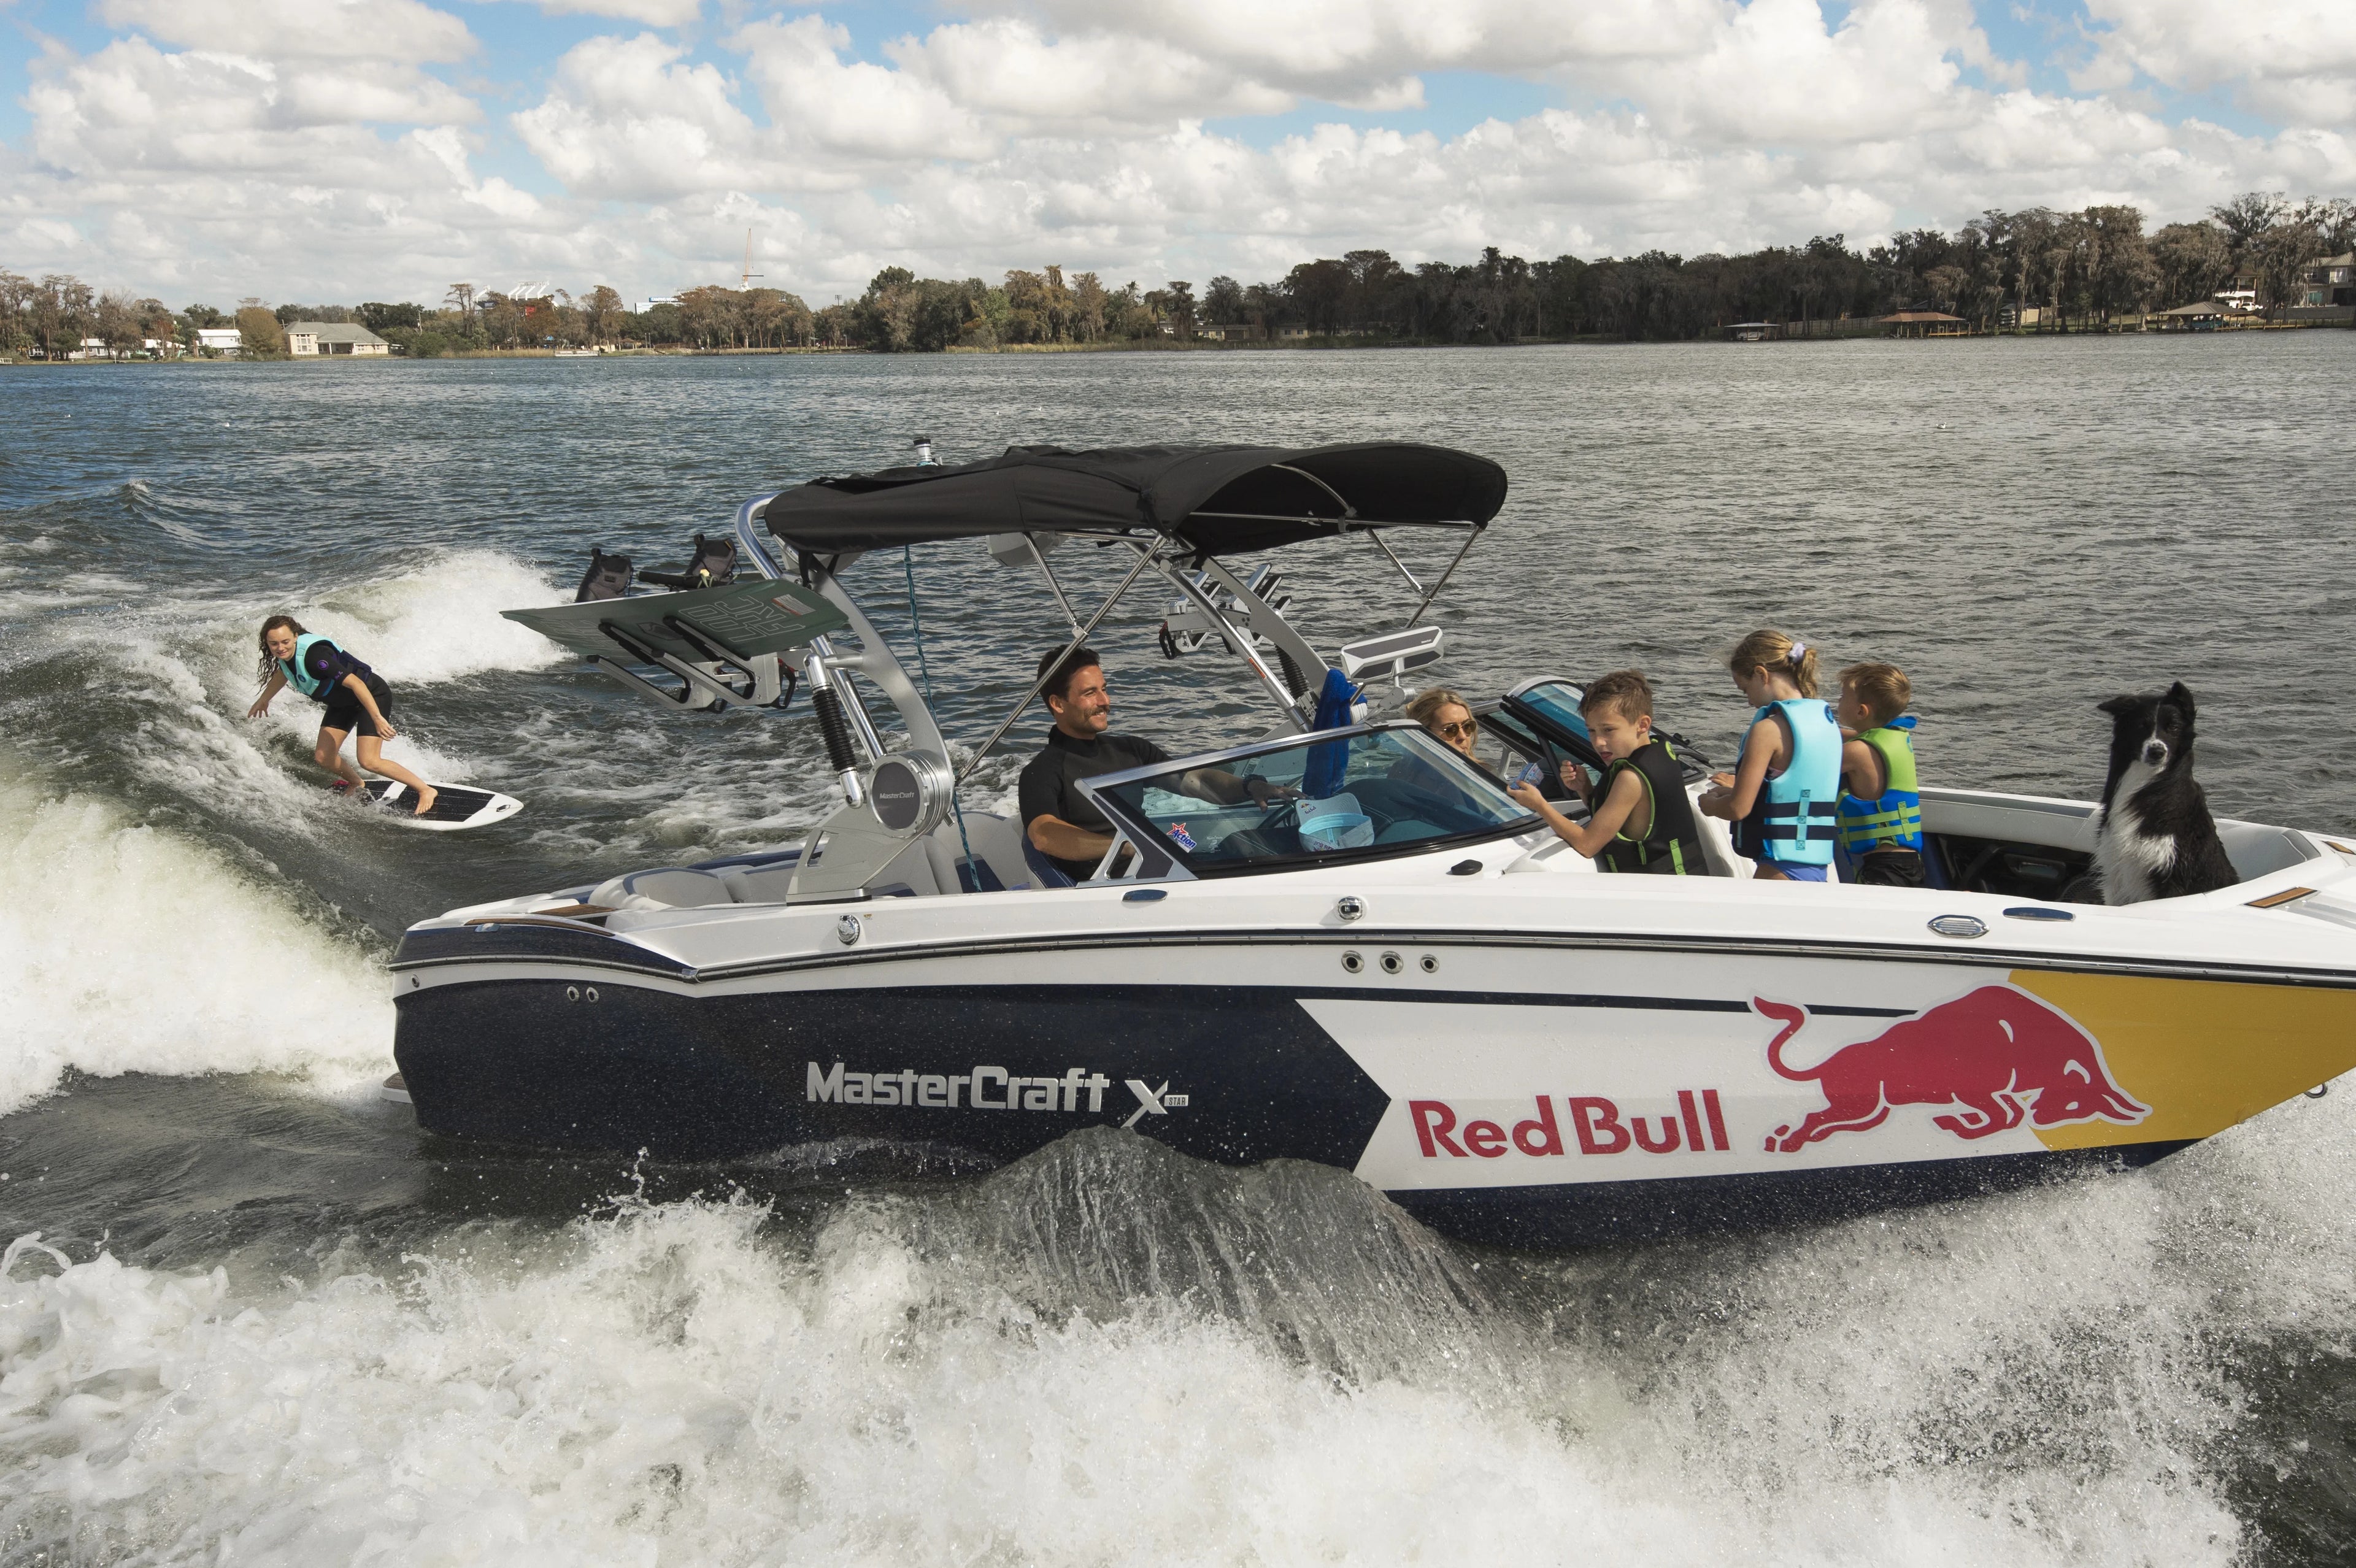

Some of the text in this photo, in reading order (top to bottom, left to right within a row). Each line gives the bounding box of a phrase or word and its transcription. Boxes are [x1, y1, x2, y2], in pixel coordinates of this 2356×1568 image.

[1172, 829, 1196, 848] Action
[807, 1062, 1185, 1128] MasterCraft X STAR
[1409, 1089, 1730, 1158] Red Bull
